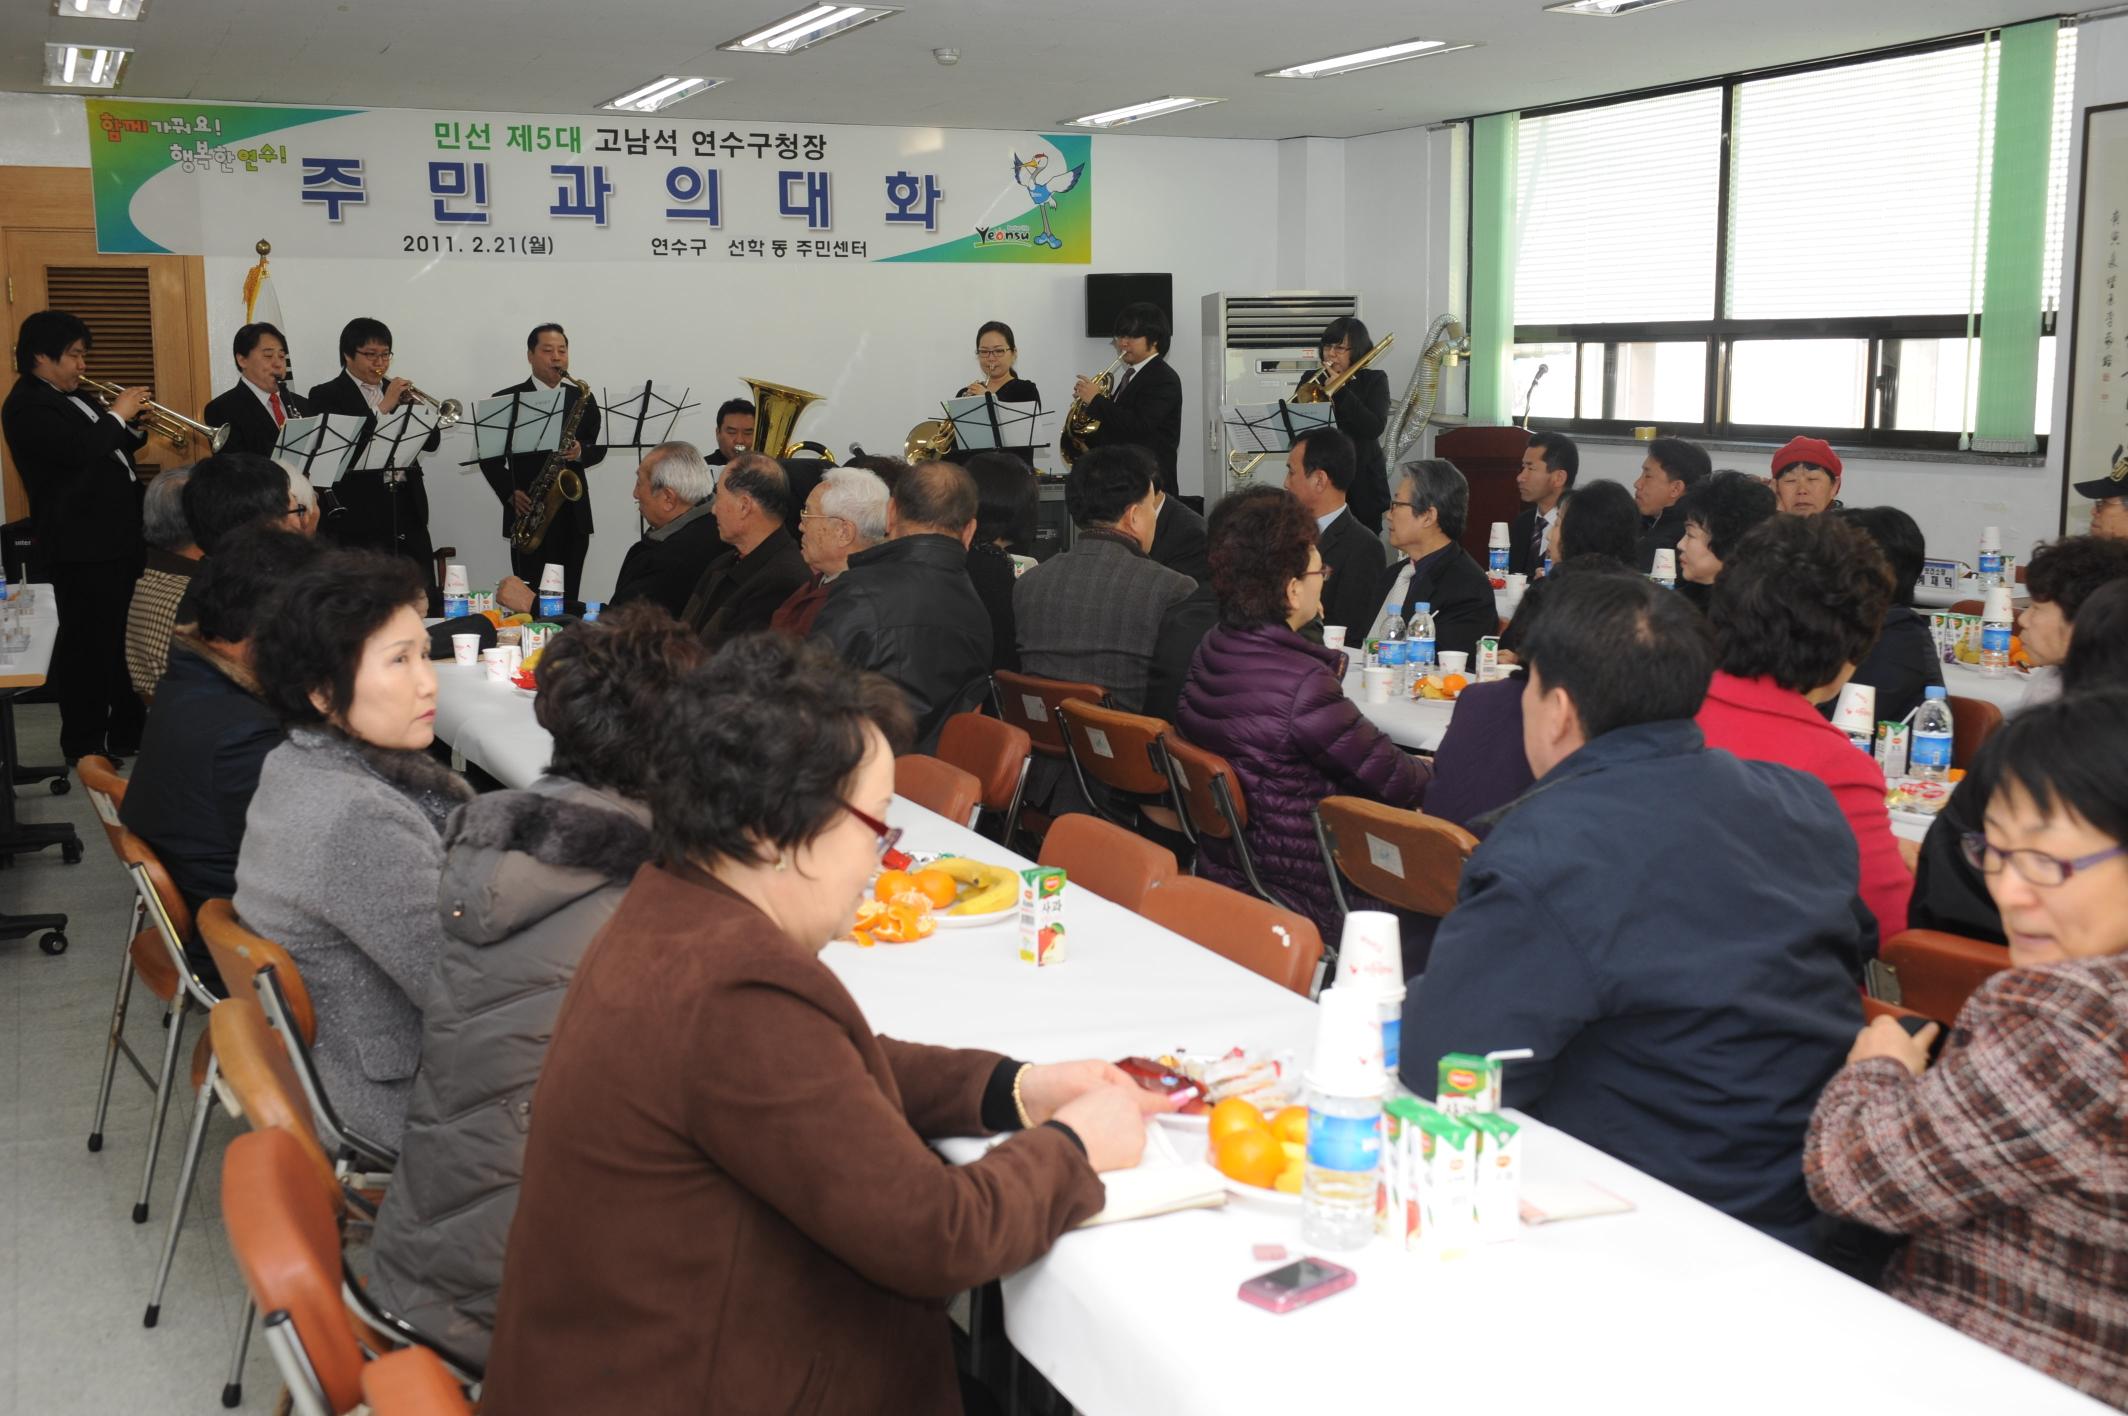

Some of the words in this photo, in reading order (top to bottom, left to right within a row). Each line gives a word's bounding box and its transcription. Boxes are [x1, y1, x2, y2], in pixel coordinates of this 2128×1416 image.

[100, 112, 149, 142] 함께
[434, 122, 492, 151] 민선
[506, 124, 582, 154] 제5대
[595, 128, 678, 156] 고남석
[691, 130, 828, 161] 연수구청장
[169, 140, 236, 173] 행복한
[237, 143, 287, 172] 연수!
[651, 237, 708, 257] 연수구
[796, 240, 867, 258] 주민센터
[975, 226, 1030, 245] Yeonsu
